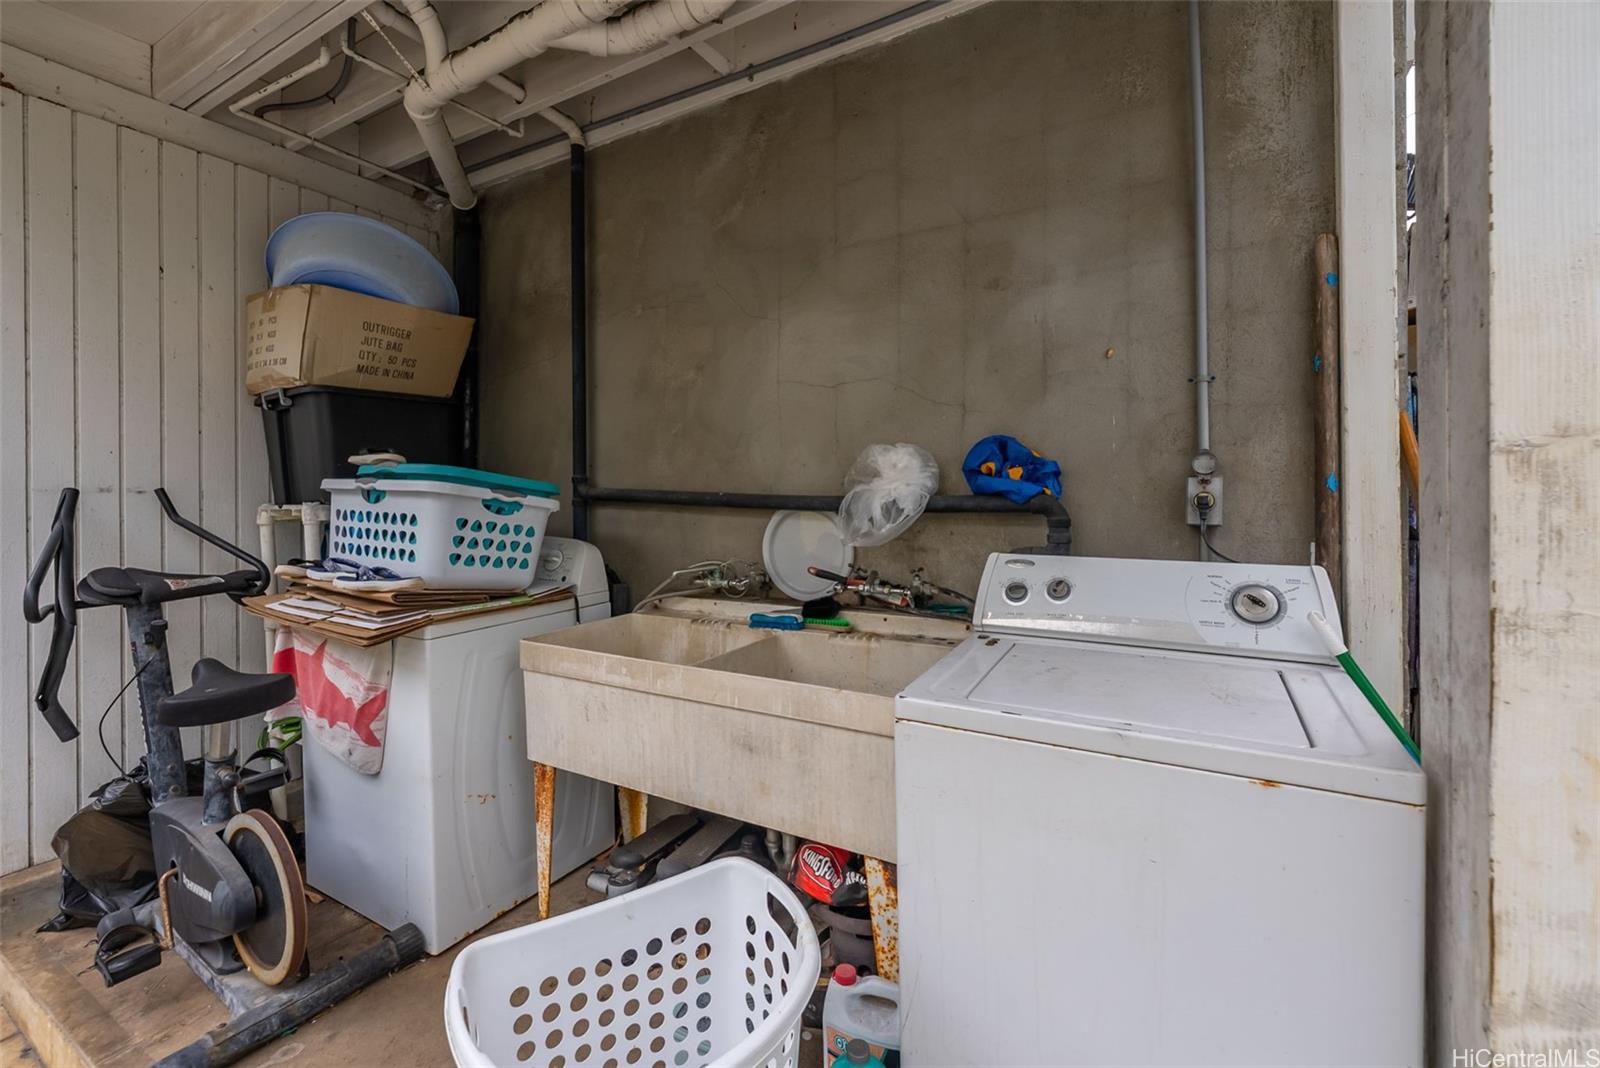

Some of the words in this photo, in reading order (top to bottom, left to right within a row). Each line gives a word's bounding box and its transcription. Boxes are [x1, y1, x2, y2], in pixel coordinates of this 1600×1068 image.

[362, 320, 412, 340] OUTRIGGER
[361, 336, 384, 349] JUTE
[385, 340, 404, 353] BAG
[387, 355, 398, 366] 50
[401, 357, 417, 368] PCS
[356, 364, 380, 376] MADE
[382, 367, 391, 377] IN
[392, 369, 415, 380] CHINA
[803, 848, 841, 888] KINGSFORD
